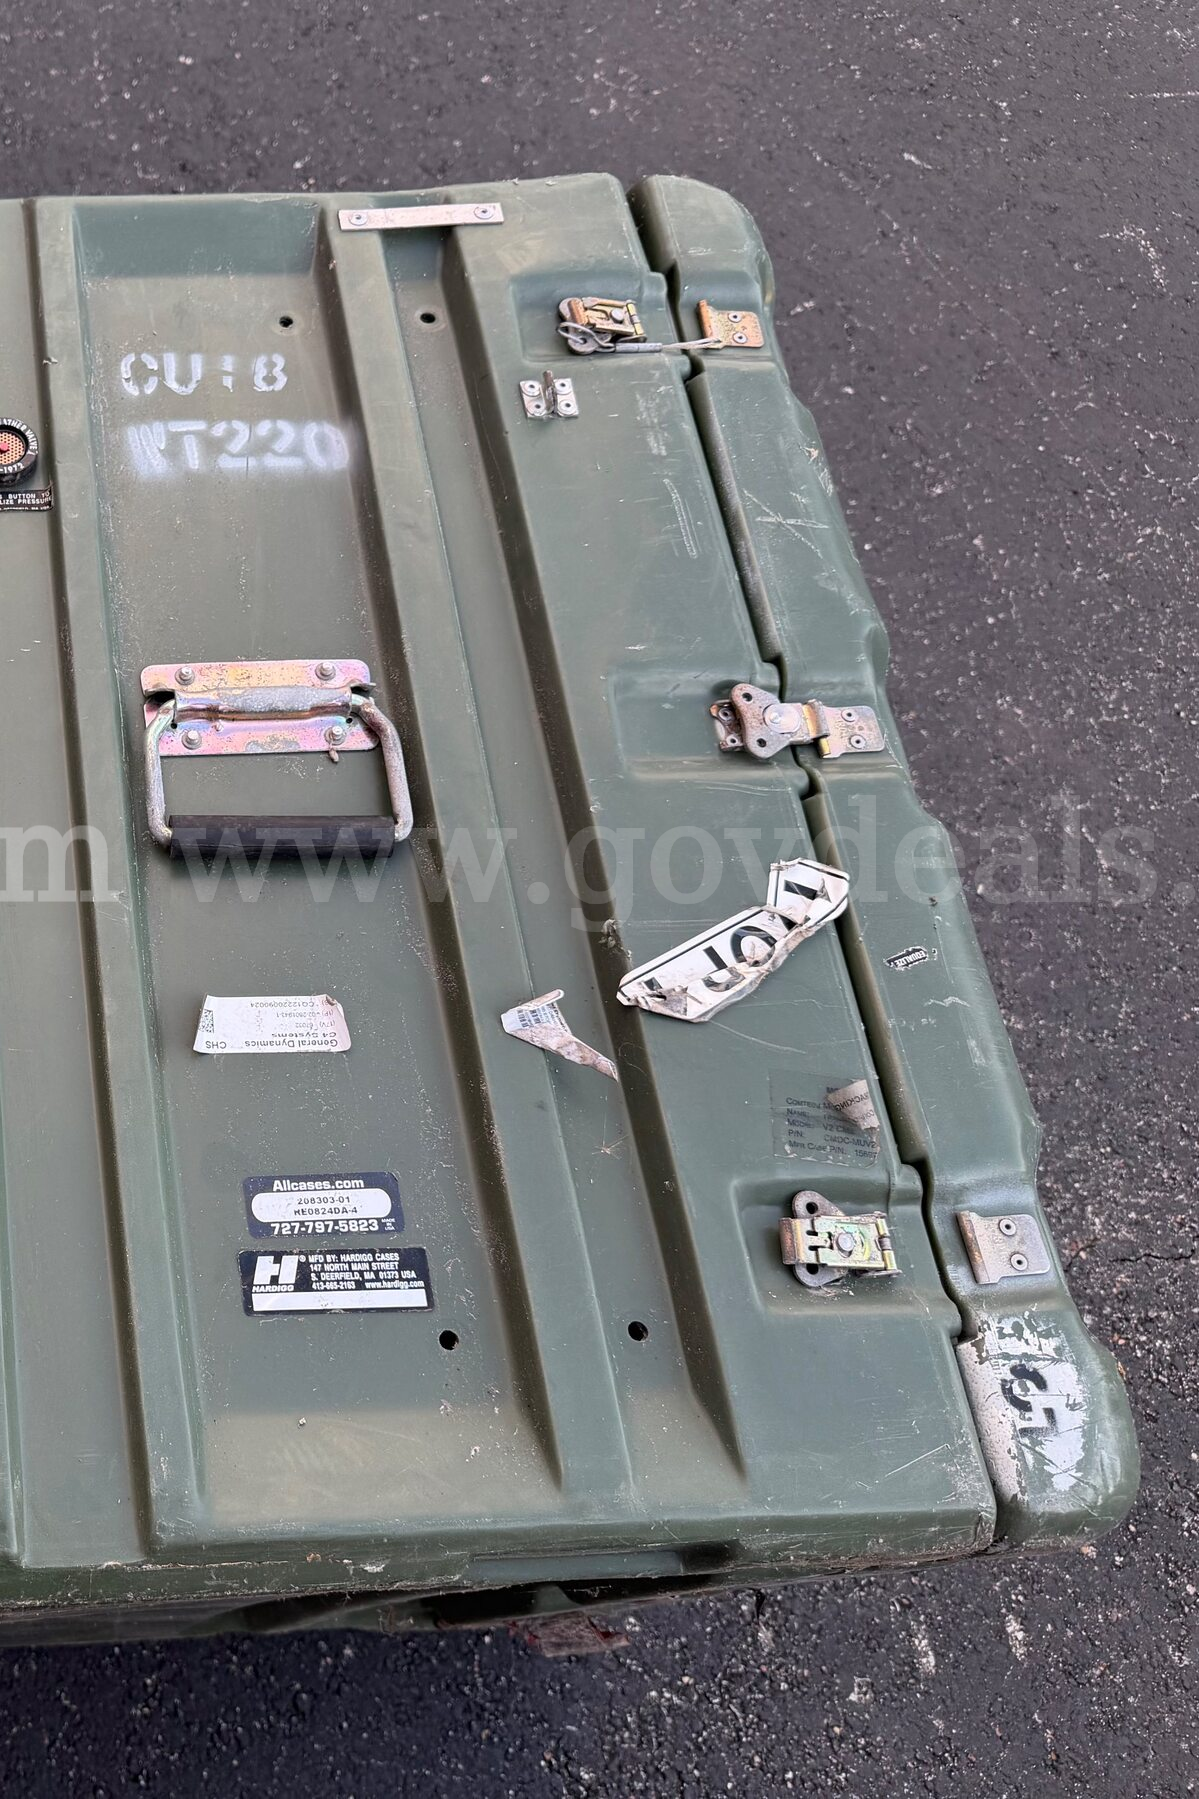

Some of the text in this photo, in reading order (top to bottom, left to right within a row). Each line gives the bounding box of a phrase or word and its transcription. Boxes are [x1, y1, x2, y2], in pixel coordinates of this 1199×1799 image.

[205, 1038, 338, 1049] General Dynamics CHS
[272, 1179, 364, 1192] Allcases.com
[270, 1219, 379, 1235] 727-797-5823
[308, 1252, 400, 1263] MFD BY: HARDIGG CASES
[309, 1262, 399, 1272] 147 NORTH MAIN STREET
[320, 1271, 362, 1281] DEERFIELD,
[363, 1271, 376, 1280] MA
[378, 1271, 399, 1279] 01373
[401, 1270, 417, 1279] USA
[251, 1285, 295, 1293] HARDIGG
[312, 1280, 425, 1290] 413-665-2163 www.hardigg.com
